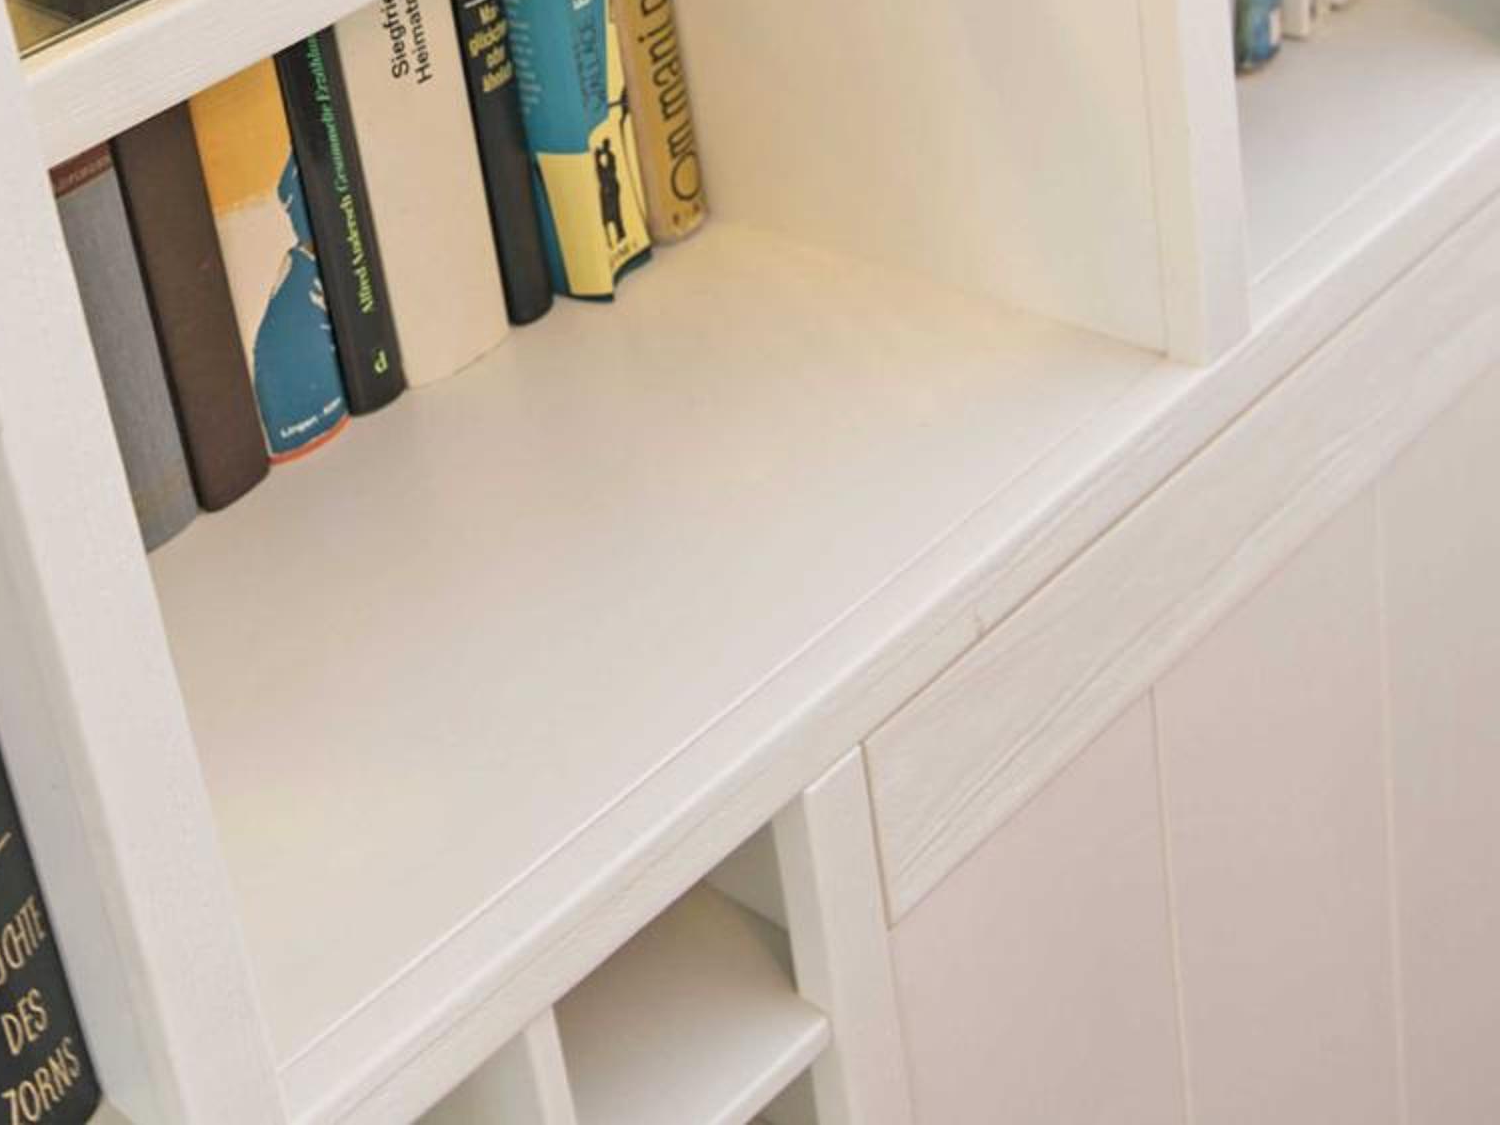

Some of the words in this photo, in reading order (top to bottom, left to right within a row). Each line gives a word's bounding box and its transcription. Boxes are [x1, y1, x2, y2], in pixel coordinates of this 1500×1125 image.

[637, 28, 691, 122] mani
[666, 125, 701, 202] Om
[1, 987, 48, 1057] DES
[0, 1036, 81, 1125] ZORNS
